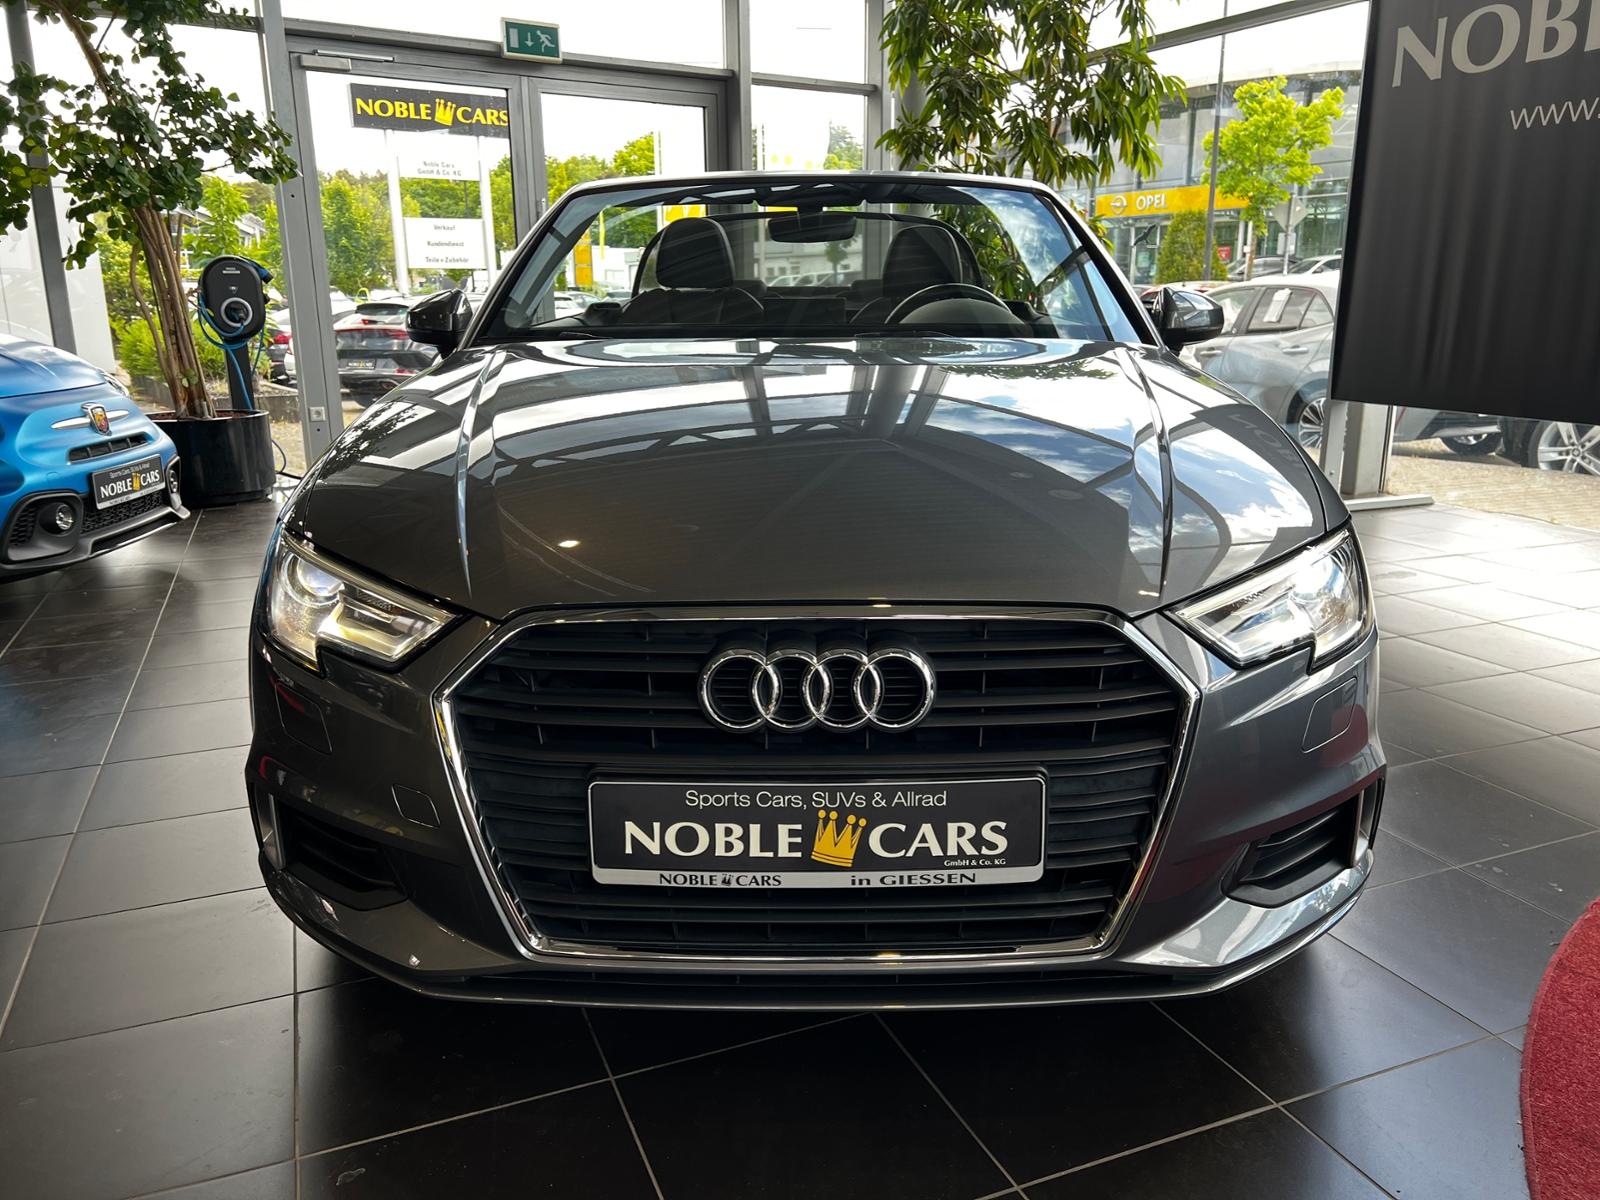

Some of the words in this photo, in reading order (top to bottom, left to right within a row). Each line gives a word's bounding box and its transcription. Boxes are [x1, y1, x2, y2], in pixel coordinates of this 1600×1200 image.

[355, 97, 432, 121] NOBLE
[456, 105, 509, 127] CARS
[1136, 193, 1166, 211] OPEL
[433, 224, 456, 232] Verkauf
[427, 240, 465, 248] Kundendienst
[100, 478, 133, 499] NOBLE
[140, 469, 160, 486] CARS
[685, 789, 751, 809] Sports
[756, 790, 807, 810] Cars,
[811, 791, 866, 808] SUVs
[871, 791, 887, 808] &
[891, 790, 947, 807] Allrad
[623, 820, 803, 858] NOBLE
[868, 820, 1009, 858] CARS
[943, 859, 969, 867] GmbH
[979, 858, 993, 866] Co.
[659, 873, 718, 886] NOBLE
[735, 874, 782, 887] CARS
[851, 875, 871, 886] in
[880, 872, 976, 886] GIESSEN
